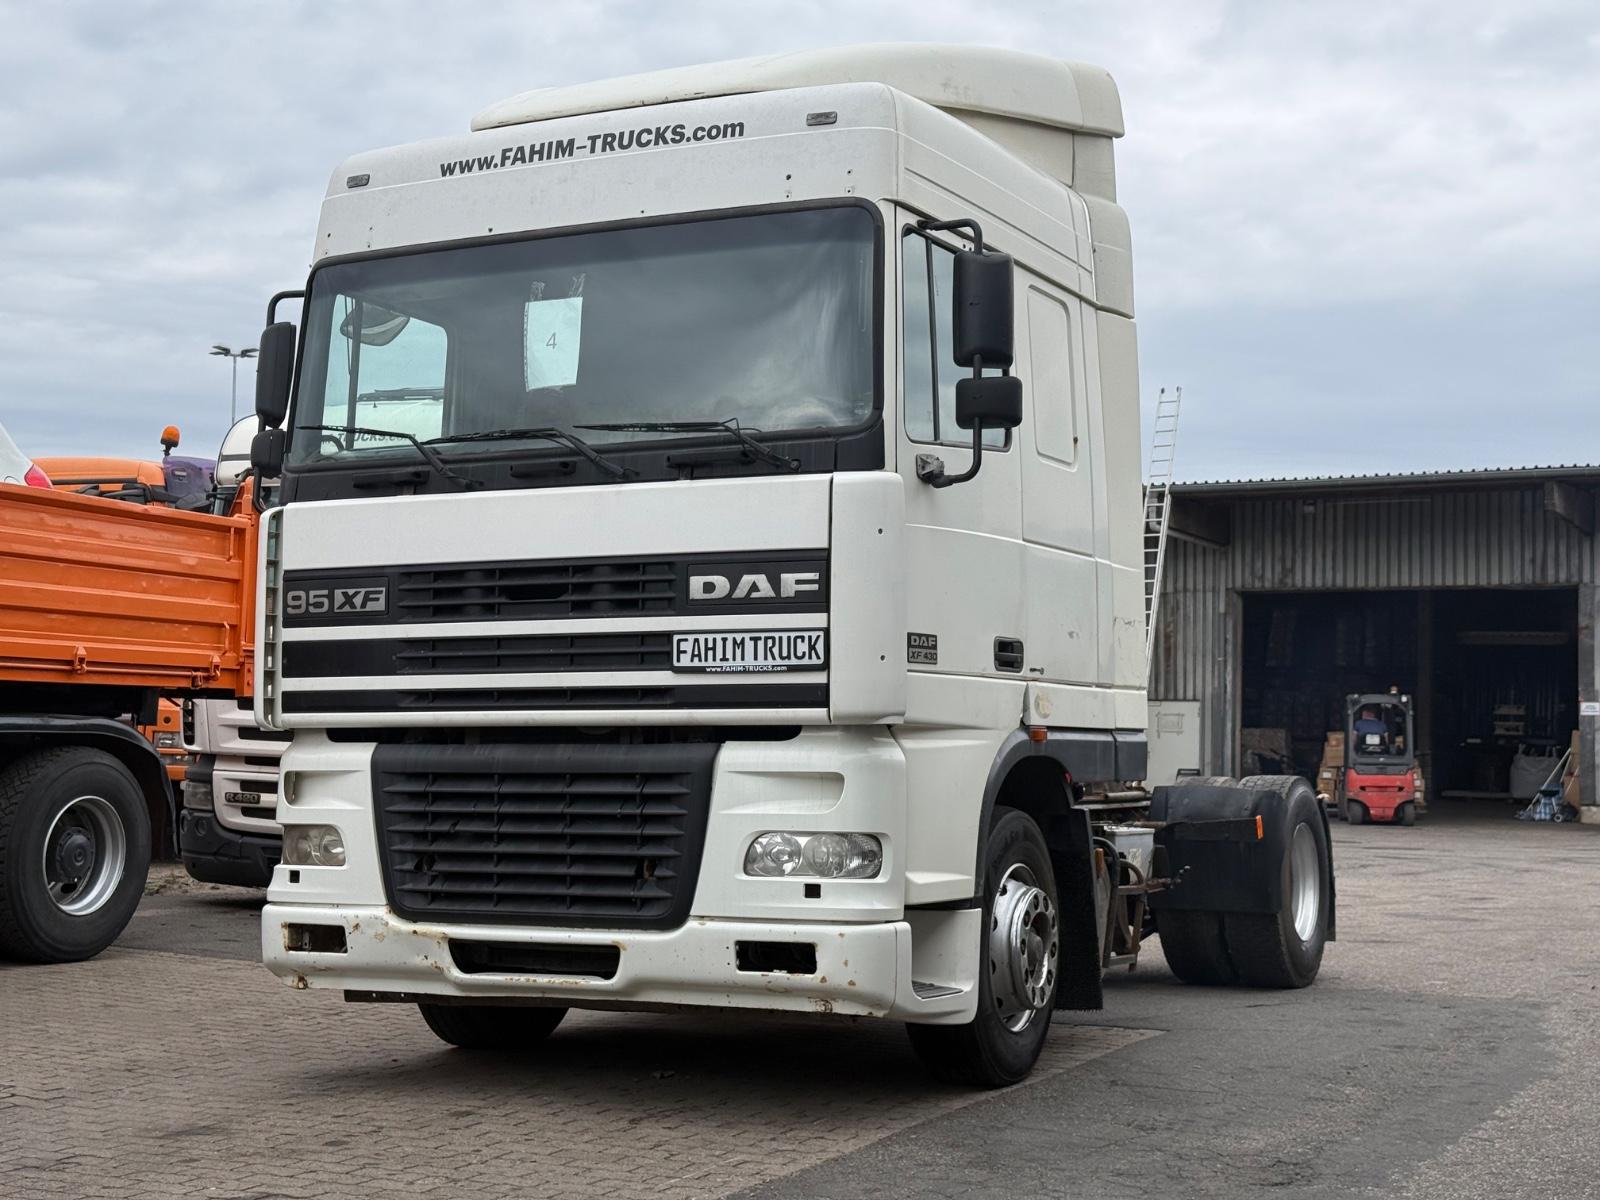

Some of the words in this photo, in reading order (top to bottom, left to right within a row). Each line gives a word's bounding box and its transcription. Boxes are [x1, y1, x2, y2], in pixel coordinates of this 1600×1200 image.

[440, 121, 745, 177] www.FAHIM-TRUCKS.com
[545, 331, 558, 350] 4
[689, 572, 820, 600] DAF
[286, 589, 329, 615] 95
[336, 589, 384, 610] XF
[676, 634, 822, 663] FAHIMTRUCK
[910, 635, 936, 647] DAF
[910, 650, 923, 660] XF
[923, 651, 937, 661] 430
